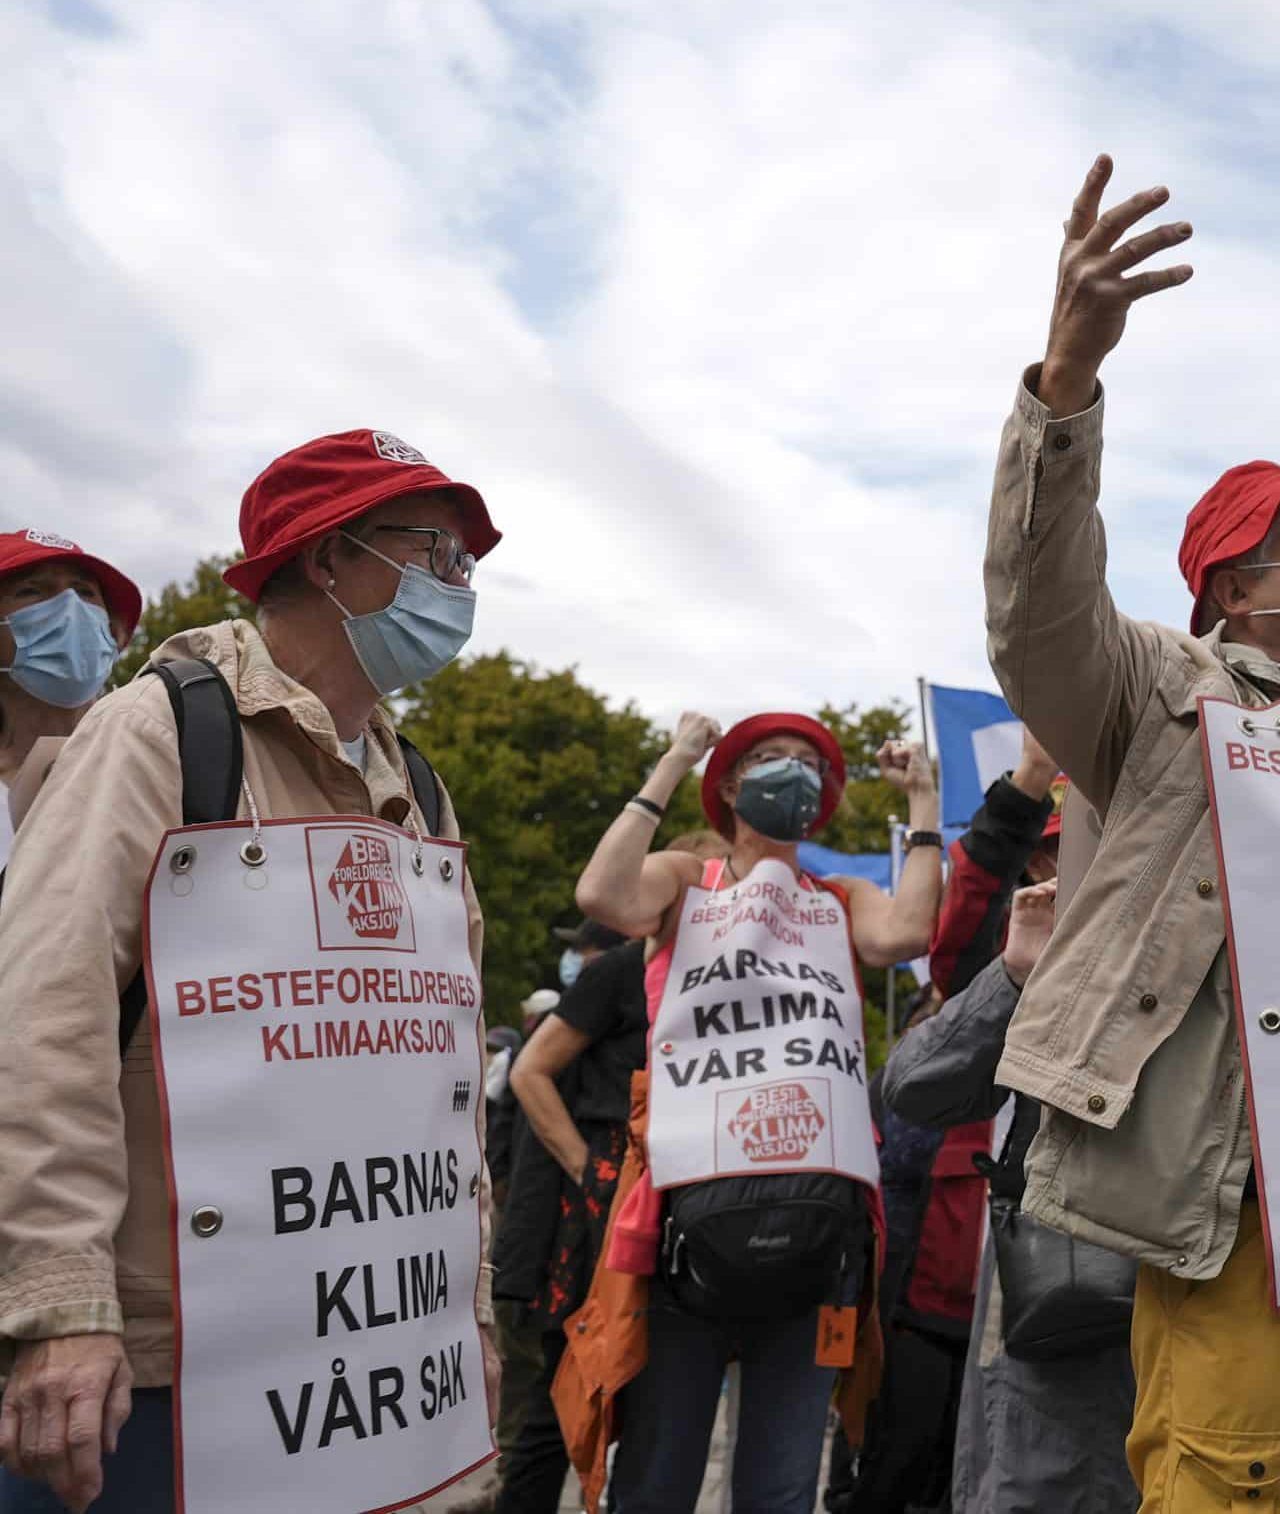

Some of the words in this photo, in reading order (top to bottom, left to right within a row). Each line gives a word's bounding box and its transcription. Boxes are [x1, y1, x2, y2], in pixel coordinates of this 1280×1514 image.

[175, 968, 476, 1017] BESTEFORELDRENES
[680, 949, 845, 995] BARNAS
[692, 992, 844, 1039] KLIMA
[261, 1019, 457, 1062] KLIMAAKSJON
[665, 1048, 768, 1087] VÅR
[783, 1037, 864, 1086] SAK
[271, 1148, 459, 1235] BARNAS
[316, 1249, 448, 1337] KLIMA
[266, 1357, 409, 1456] VÅR
[420, 1341, 467, 1421] SAK
